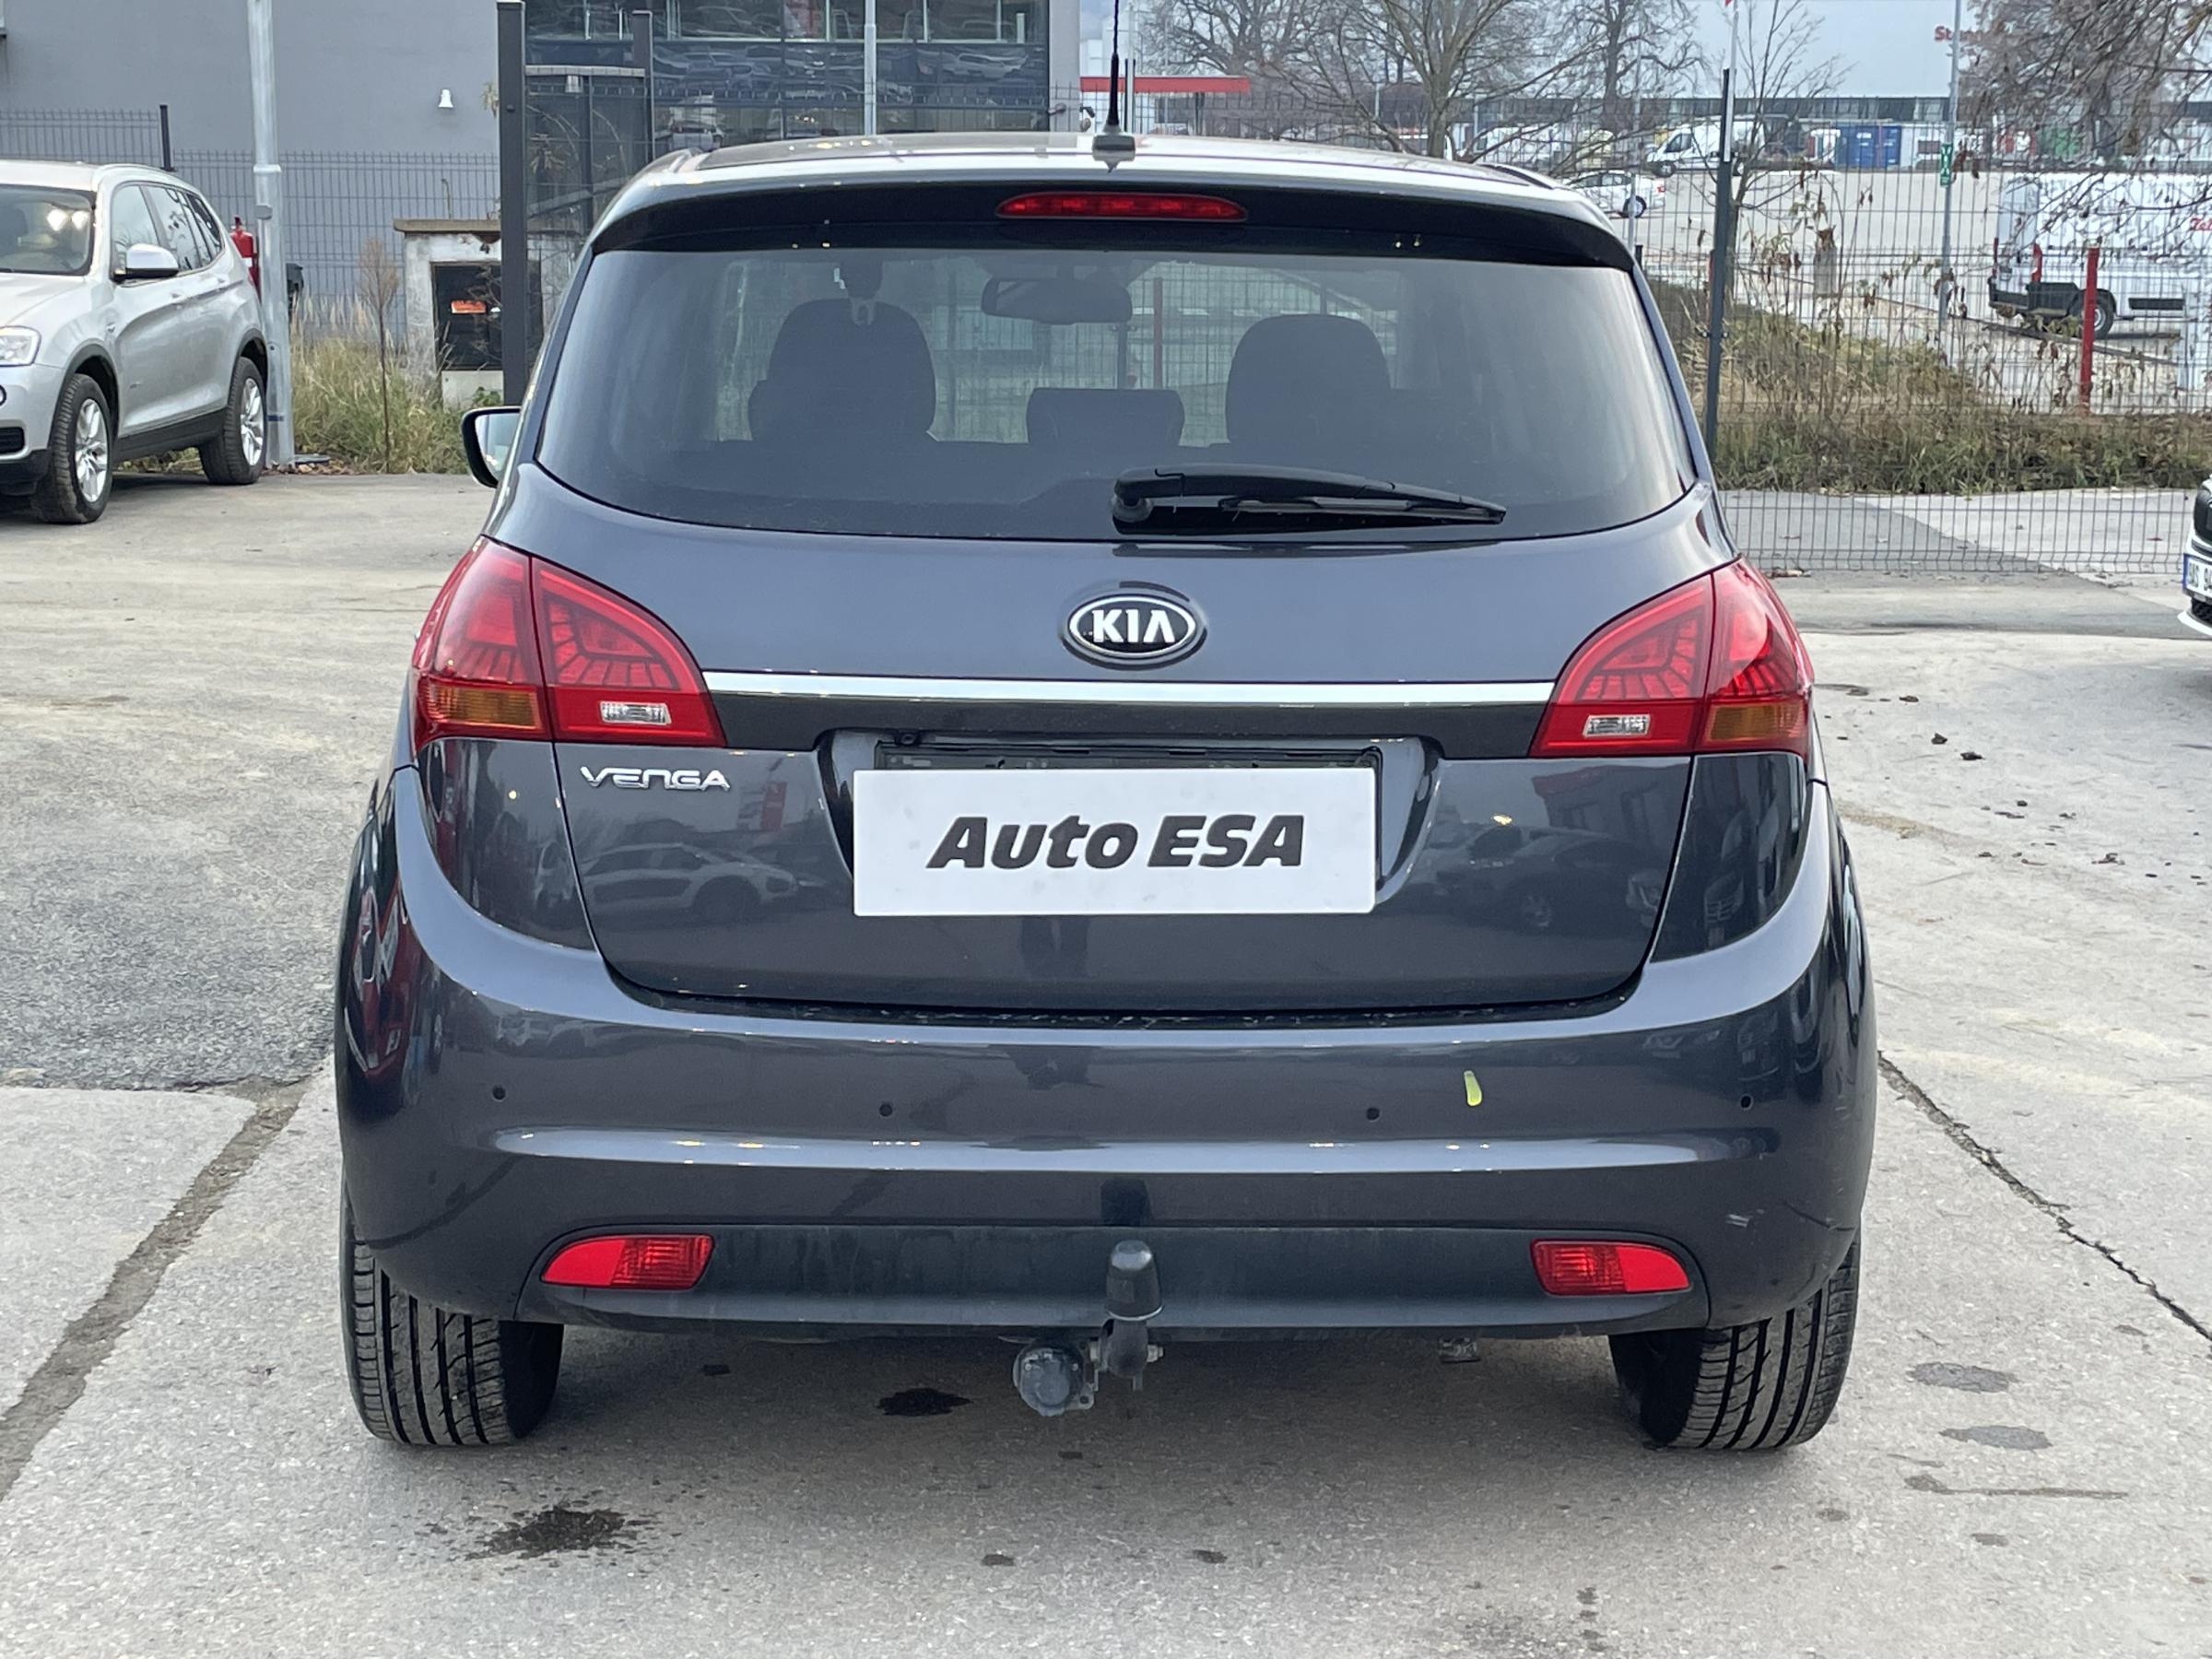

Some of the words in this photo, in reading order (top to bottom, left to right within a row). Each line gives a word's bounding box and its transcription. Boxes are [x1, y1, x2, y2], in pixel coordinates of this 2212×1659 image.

[1091, 608, 1176, 643] KIA
[580, 765, 731, 792] VENGA
[924, 815, 1139, 870] Auto
[1147, 814, 1305, 868] ESA
